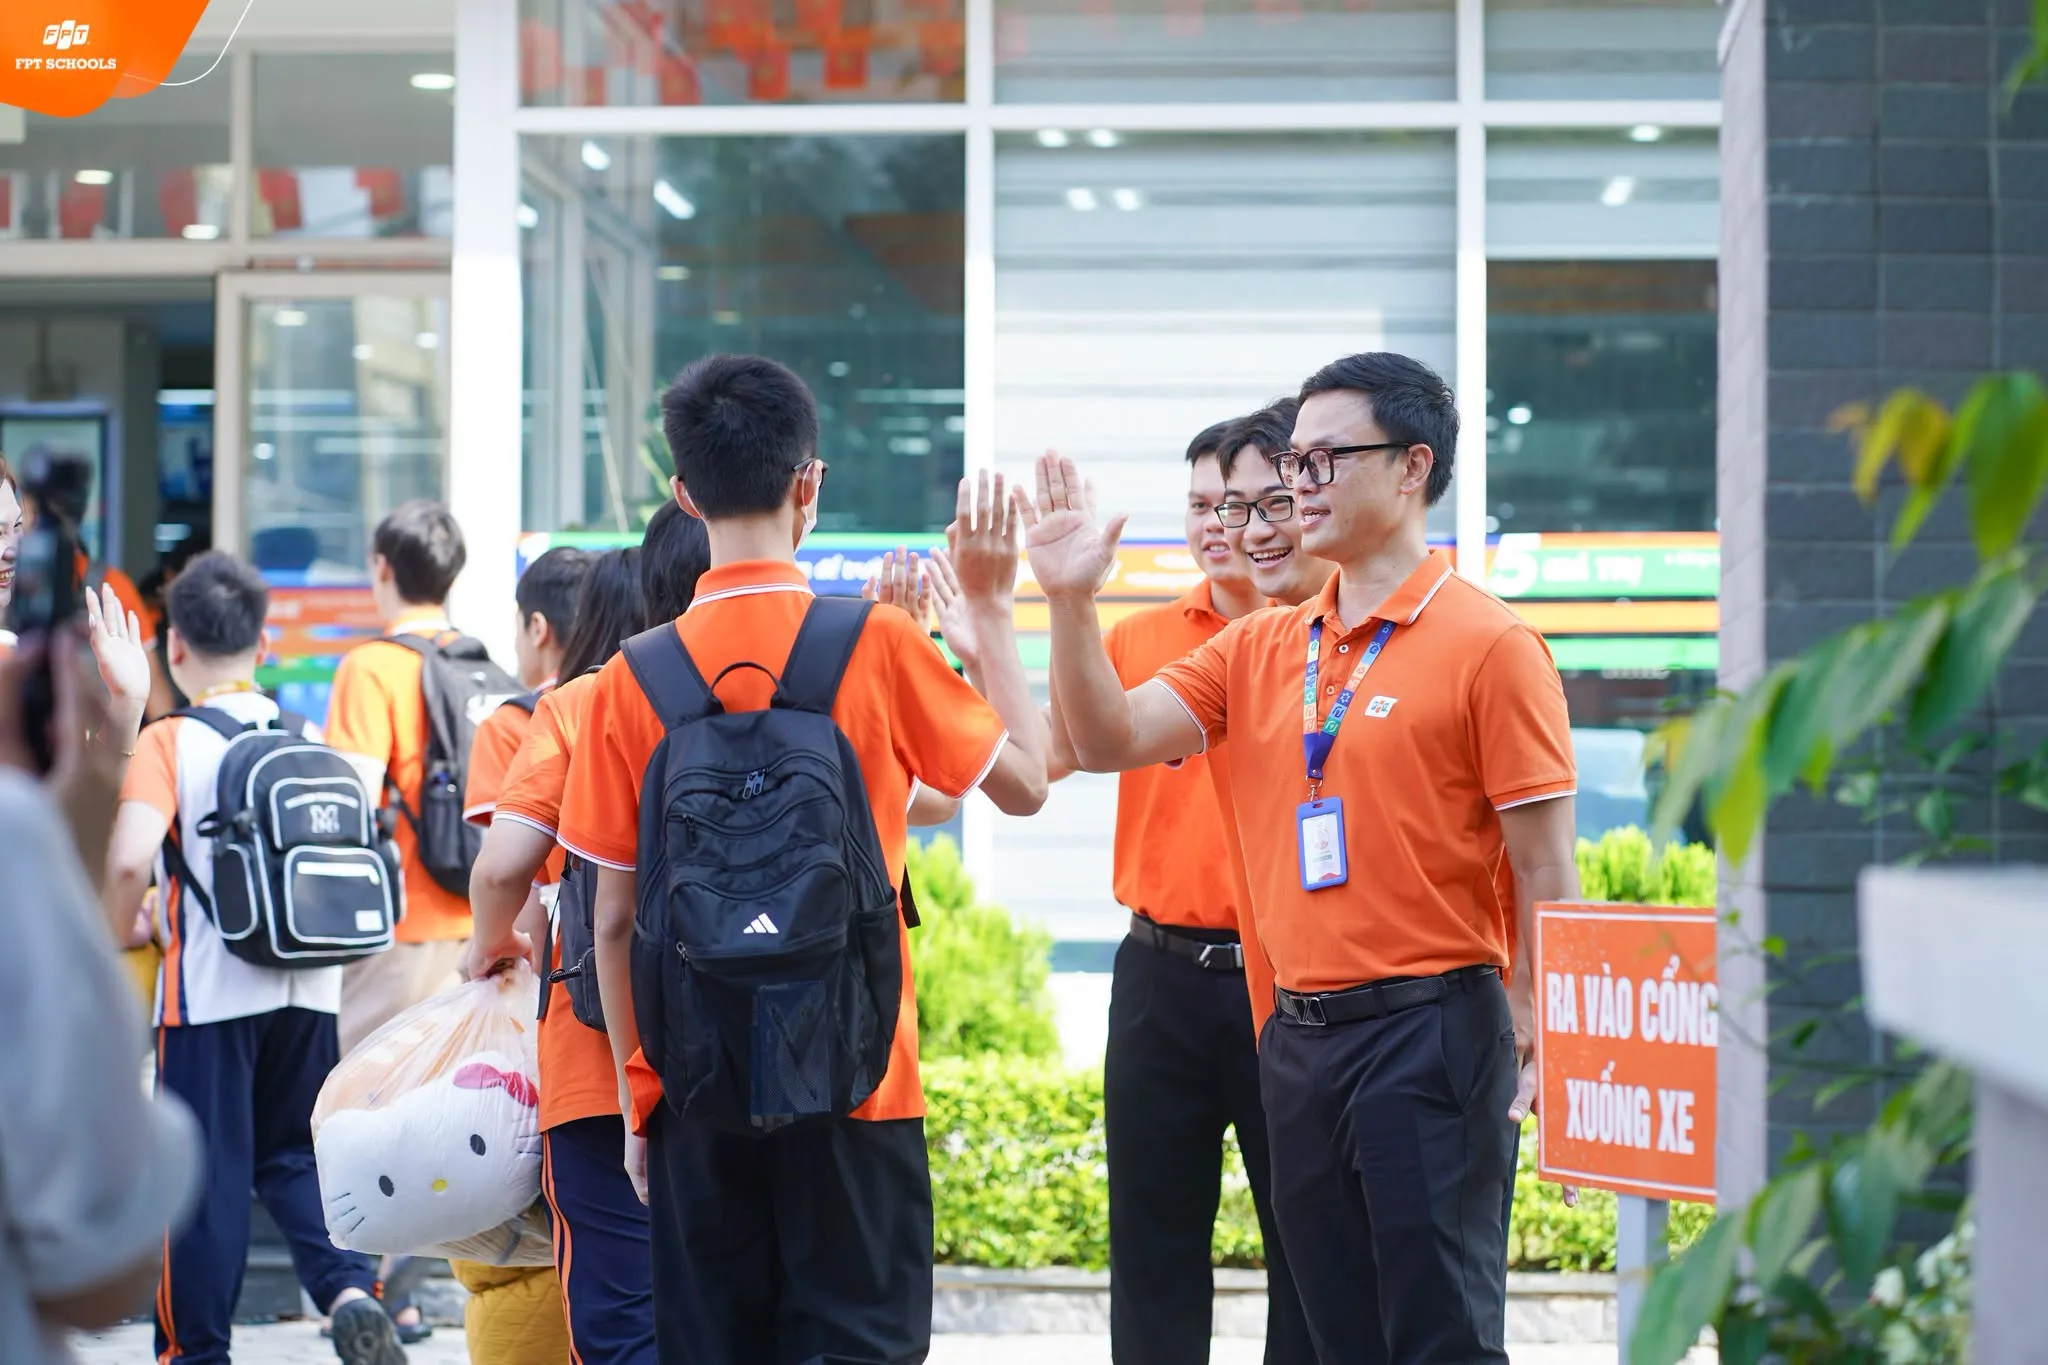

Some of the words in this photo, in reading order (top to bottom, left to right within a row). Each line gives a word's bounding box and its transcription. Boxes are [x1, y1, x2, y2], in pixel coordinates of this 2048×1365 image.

[1546, 972, 1579, 1035] RA
[1583, 962, 1633, 1040] VÀO
[1640, 954, 1719, 1047] CỔNG
[1565, 1060, 1651, 1150] XUỐNG
[1657, 1088, 1695, 1155] XE
